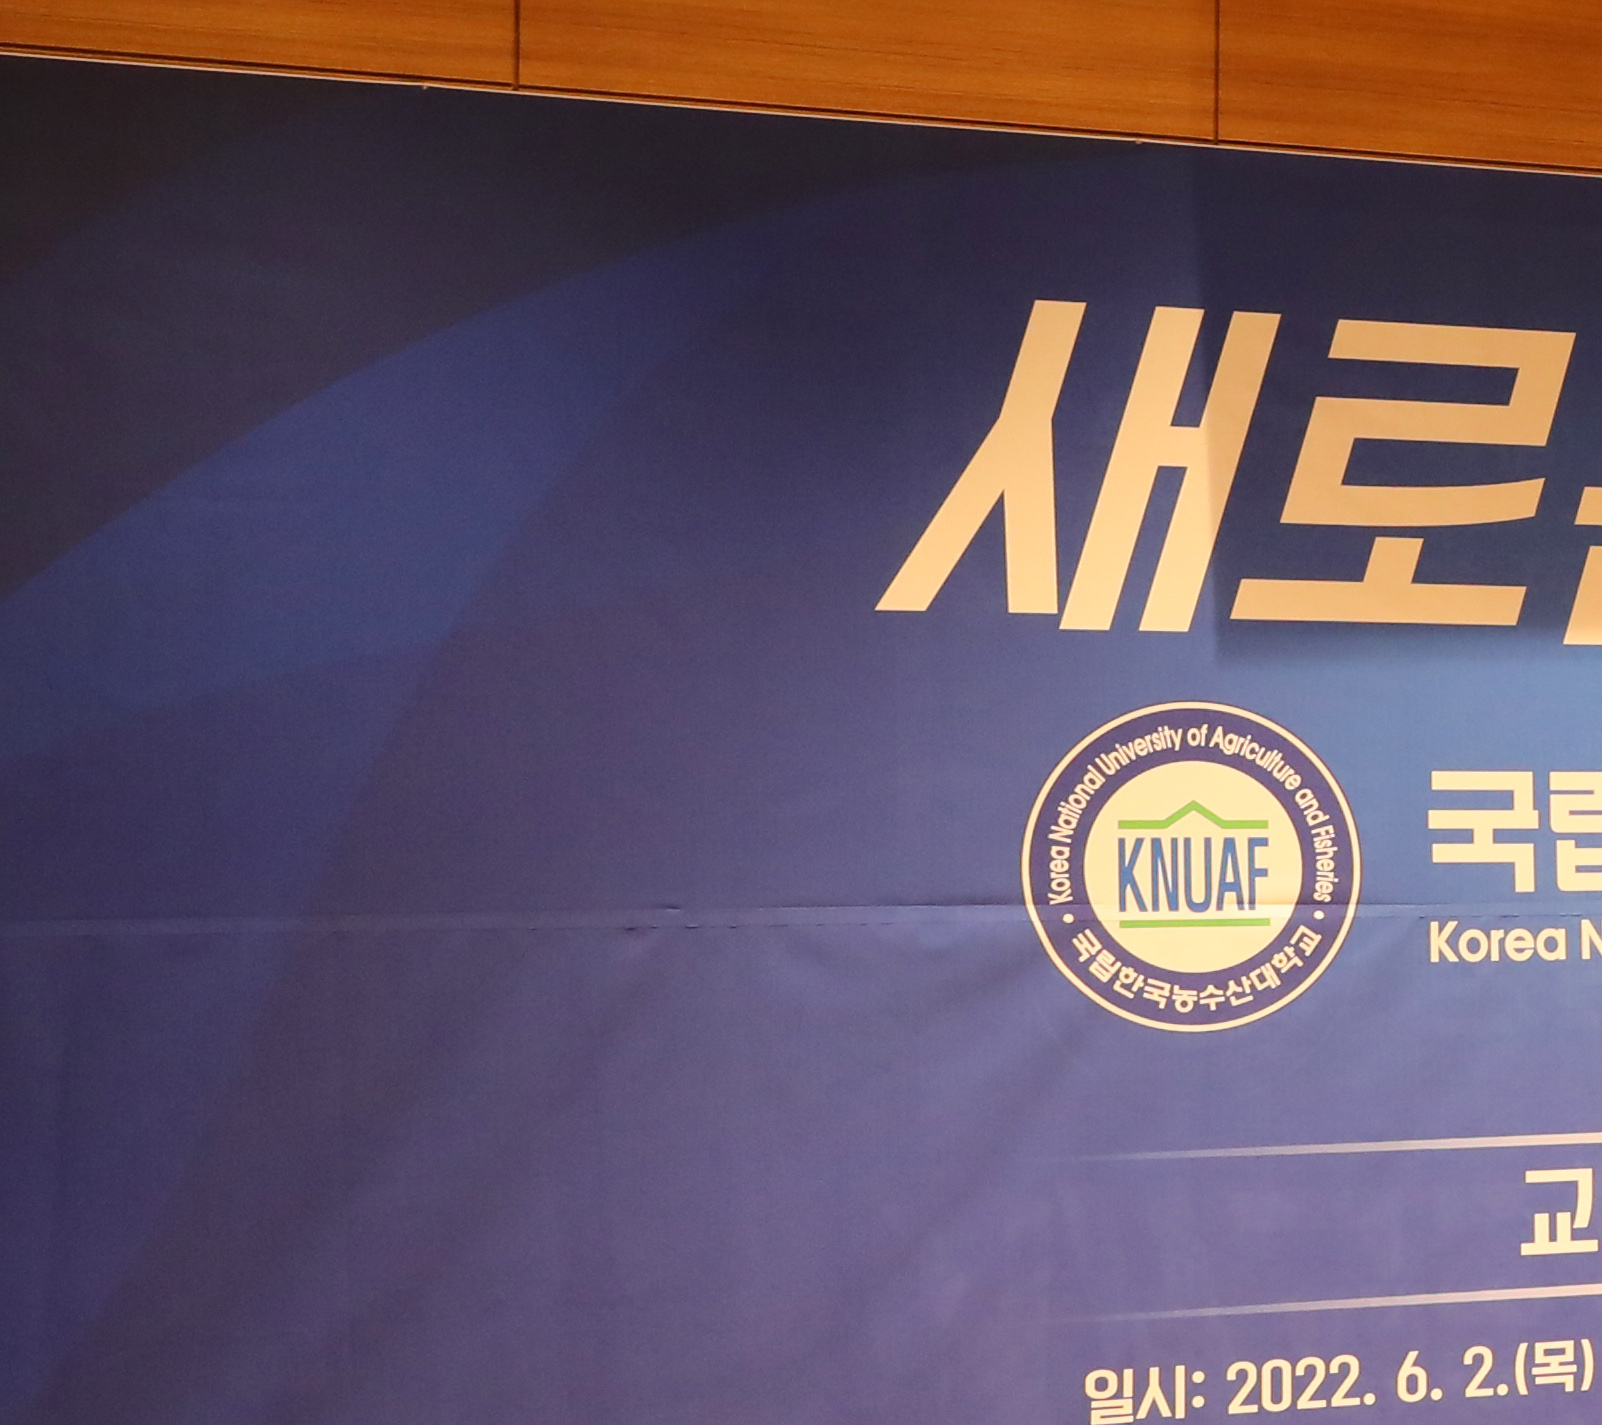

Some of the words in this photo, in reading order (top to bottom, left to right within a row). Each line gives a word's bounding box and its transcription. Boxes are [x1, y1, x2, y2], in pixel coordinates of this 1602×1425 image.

[1099, 725, 1182, 776] University
[1187, 724, 1208, 747] of
[1209, 726, 1302, 790] Agriculture
[1048, 764, 1104, 844] National
[1295, 787, 1329, 827] and
[1049, 846, 1074, 905] Korea
[1117, 836, 1269, 912] KNUAF
[1309, 824, 1338, 903] Fisheries
[1072, 924, 1322, 1013] 국립한국농수산대학교
[1429, 920, 1567, 963] Korea
[1084, 1364, 1205, 1425] 일시:
[1226, 1354, 1376, 1415] 2022.
[1396, 1350, 1443, 1403] 6.
[1463, 1338, 1595, 1398] 2.(목)
